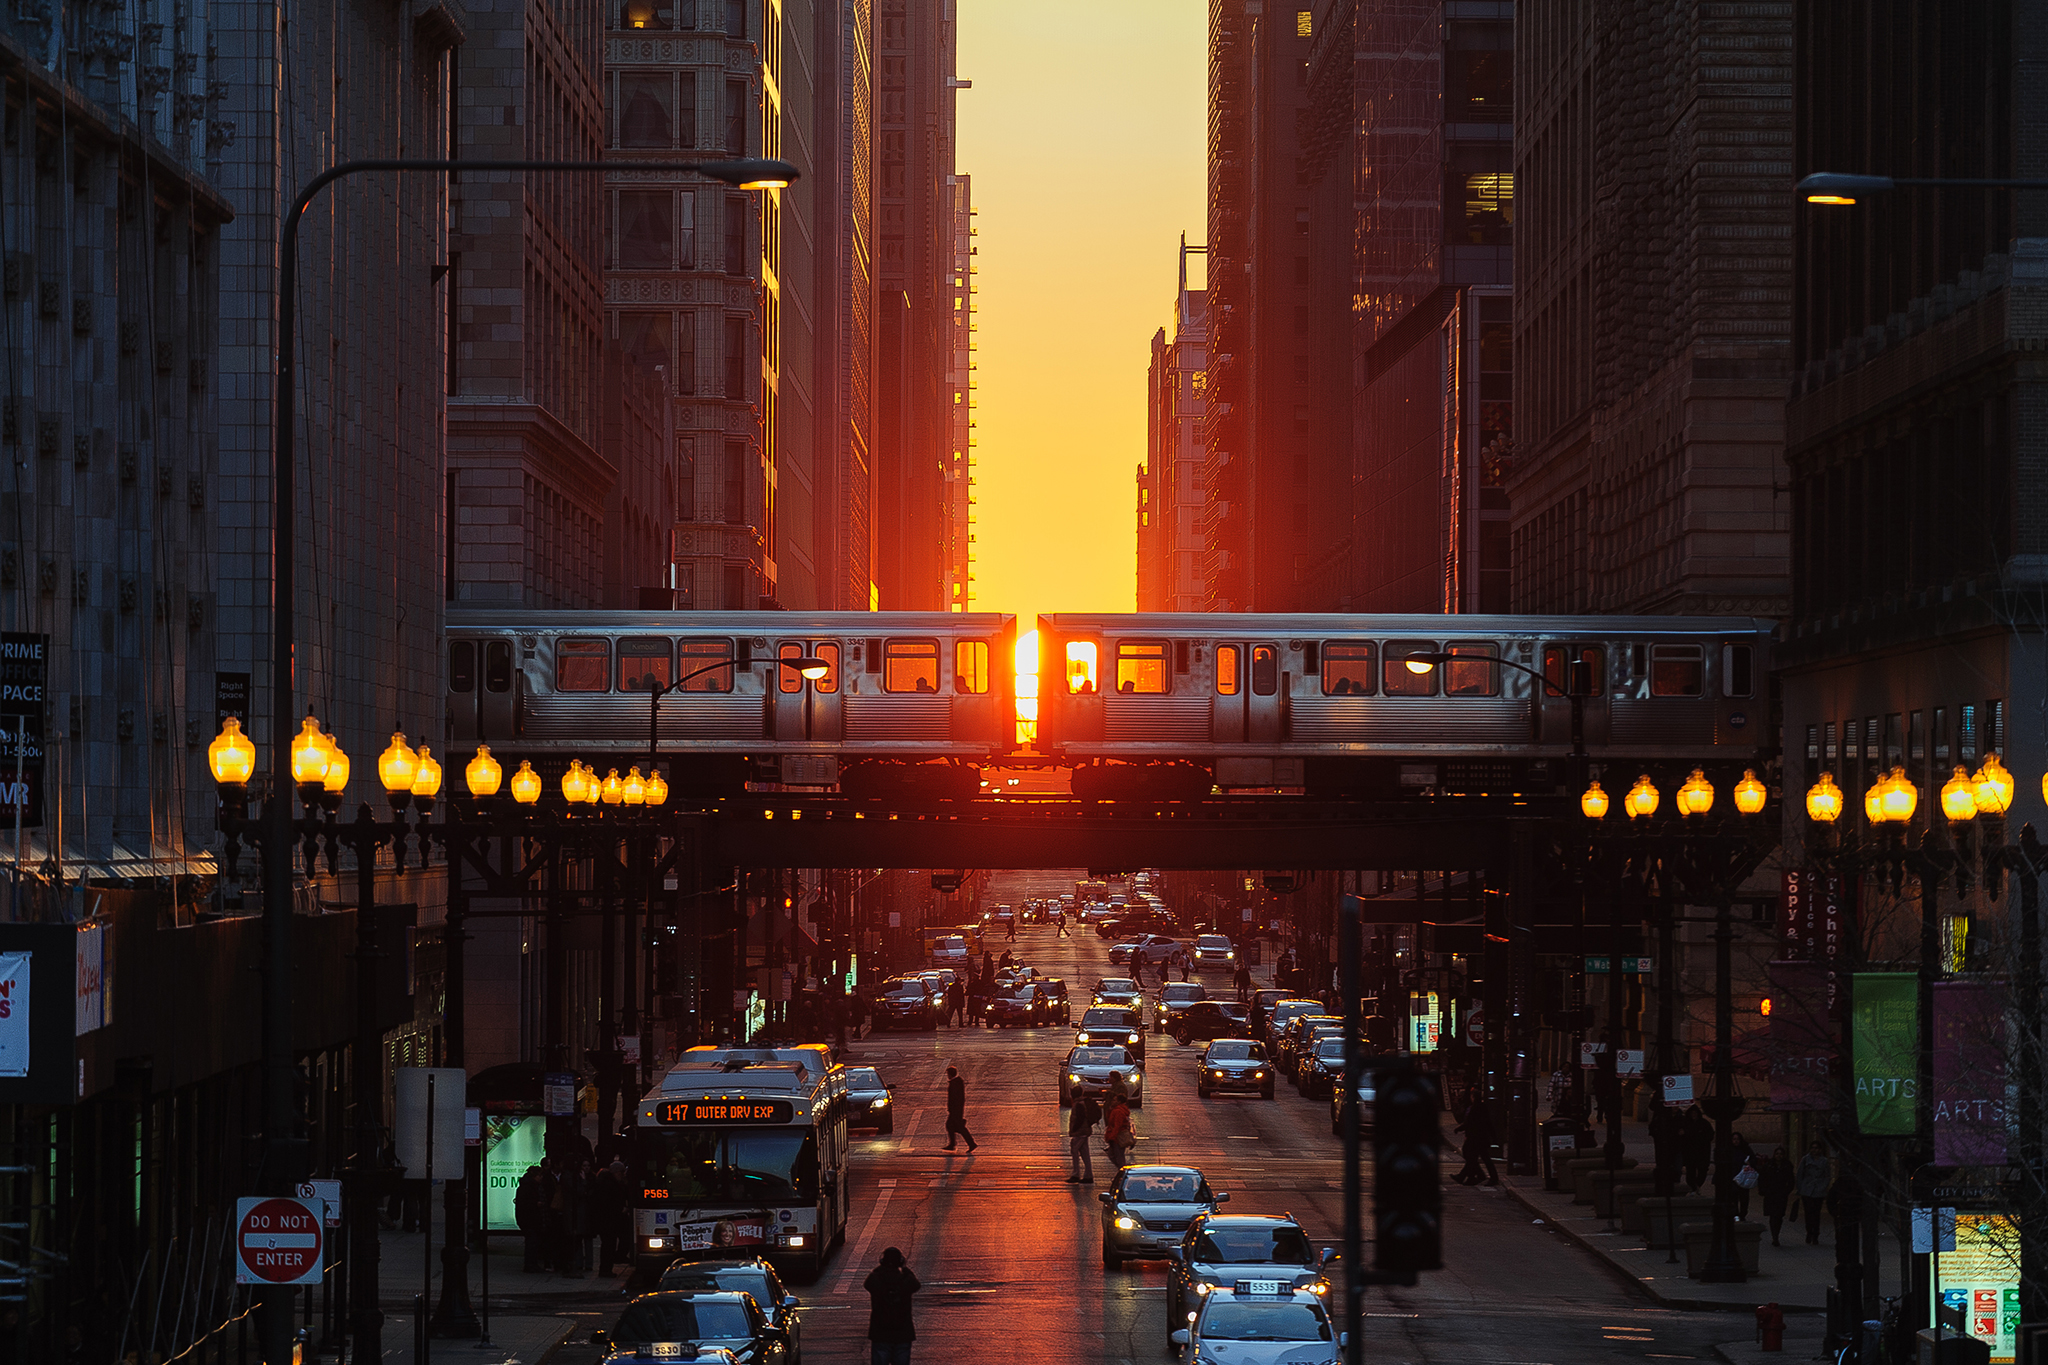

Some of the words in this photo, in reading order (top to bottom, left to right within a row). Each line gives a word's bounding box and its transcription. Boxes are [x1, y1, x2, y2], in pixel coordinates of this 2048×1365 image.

[221, 682, 243, 690] Right
[0, 684, 42, 701] PACE
[1787, 871, 1799, 920] Copy
[1594, 960, 1628, 969] Wabh
[1855, 1077, 1916, 1099] ARTS
[667, 1104, 689, 1121] 147
[695, 1106, 727, 1118] OUTER
[730, 1106, 751, 1118] DRV
[754, 1106, 774, 1118] EXP
[1934, 1099, 2005, 1121] ARTS
[491, 1176, 507, 1188] DO
[643, 1189, 669, 1198] P565
[1932, 1187, 1958, 1197] CITY
[250, 1215, 270, 1228] DO
[280, 1215, 309, 1228] NOT
[682, 1226, 712, 1236] People's
[683, 1234, 704, 1242] Court
[256, 1253, 303, 1266] ENTER
[1252, 1282, 1276, 1291] 5535
